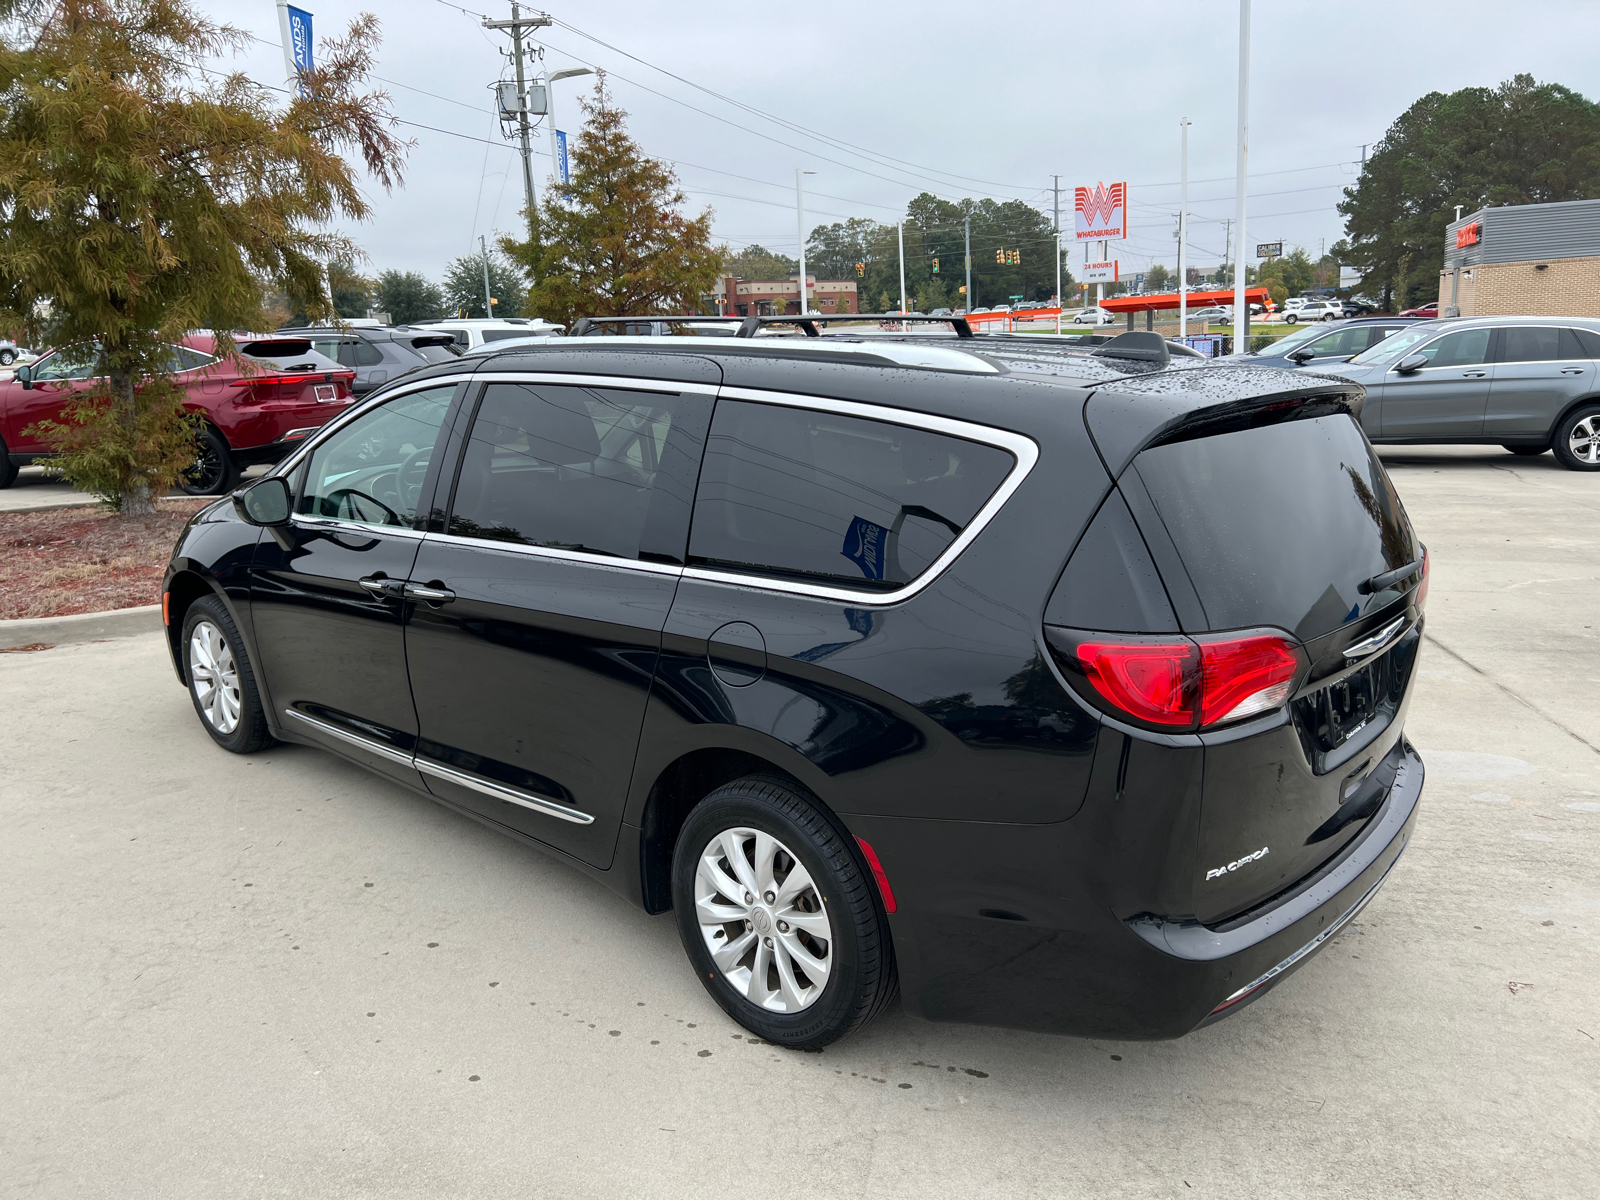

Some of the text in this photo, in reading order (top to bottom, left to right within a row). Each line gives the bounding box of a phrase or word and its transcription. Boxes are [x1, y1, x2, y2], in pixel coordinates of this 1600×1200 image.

[292, 16, 306, 67] ANDS
[1076, 228, 1121, 239] WHATABURGER
[1205, 846, 1270, 881] PACIFICA
